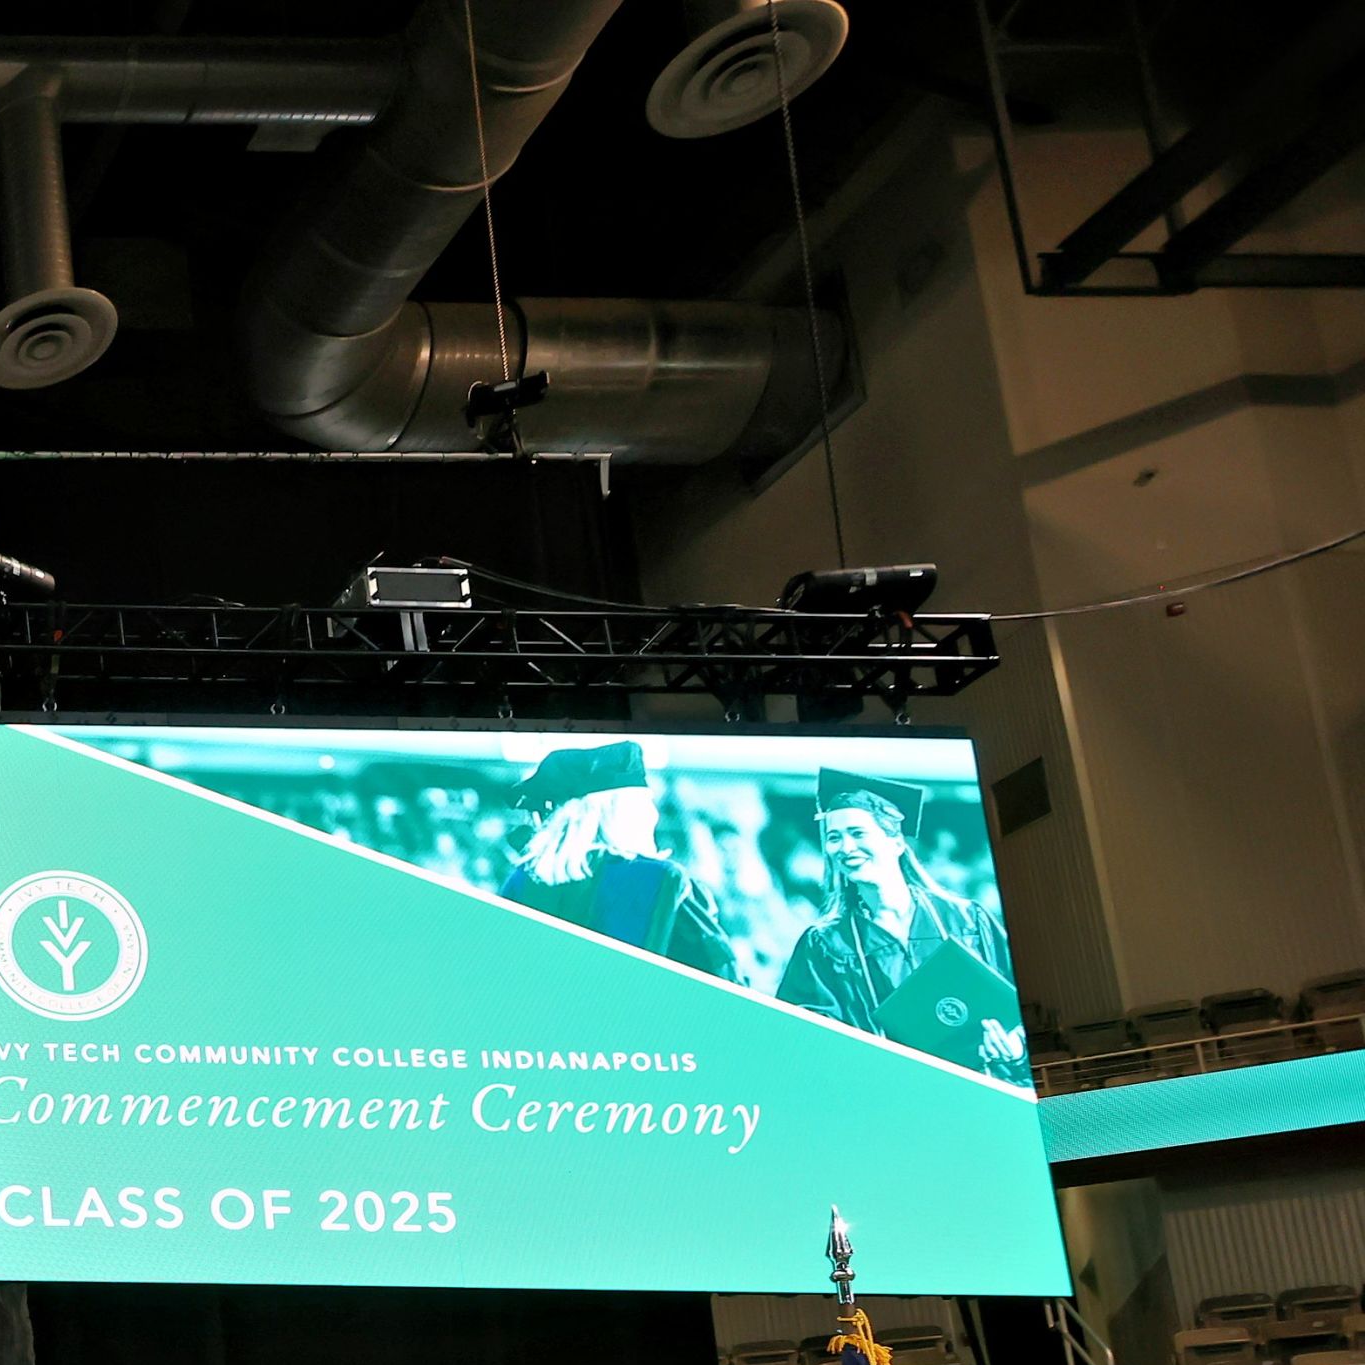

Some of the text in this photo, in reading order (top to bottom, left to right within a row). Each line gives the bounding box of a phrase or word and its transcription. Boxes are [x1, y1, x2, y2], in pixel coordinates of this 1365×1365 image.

[43, 1042, 121, 1063] TECH
[133, 1043, 319, 1067] COMMUNITY
[332, 1046, 468, 1070] COLLEGE
[480, 1049, 698, 1074] INDIANAPOLIS
[470, 1083, 761, 1155] Ceremony
[209, 1187, 293, 1231] OF
[317, 1189, 458, 1234] 2025
